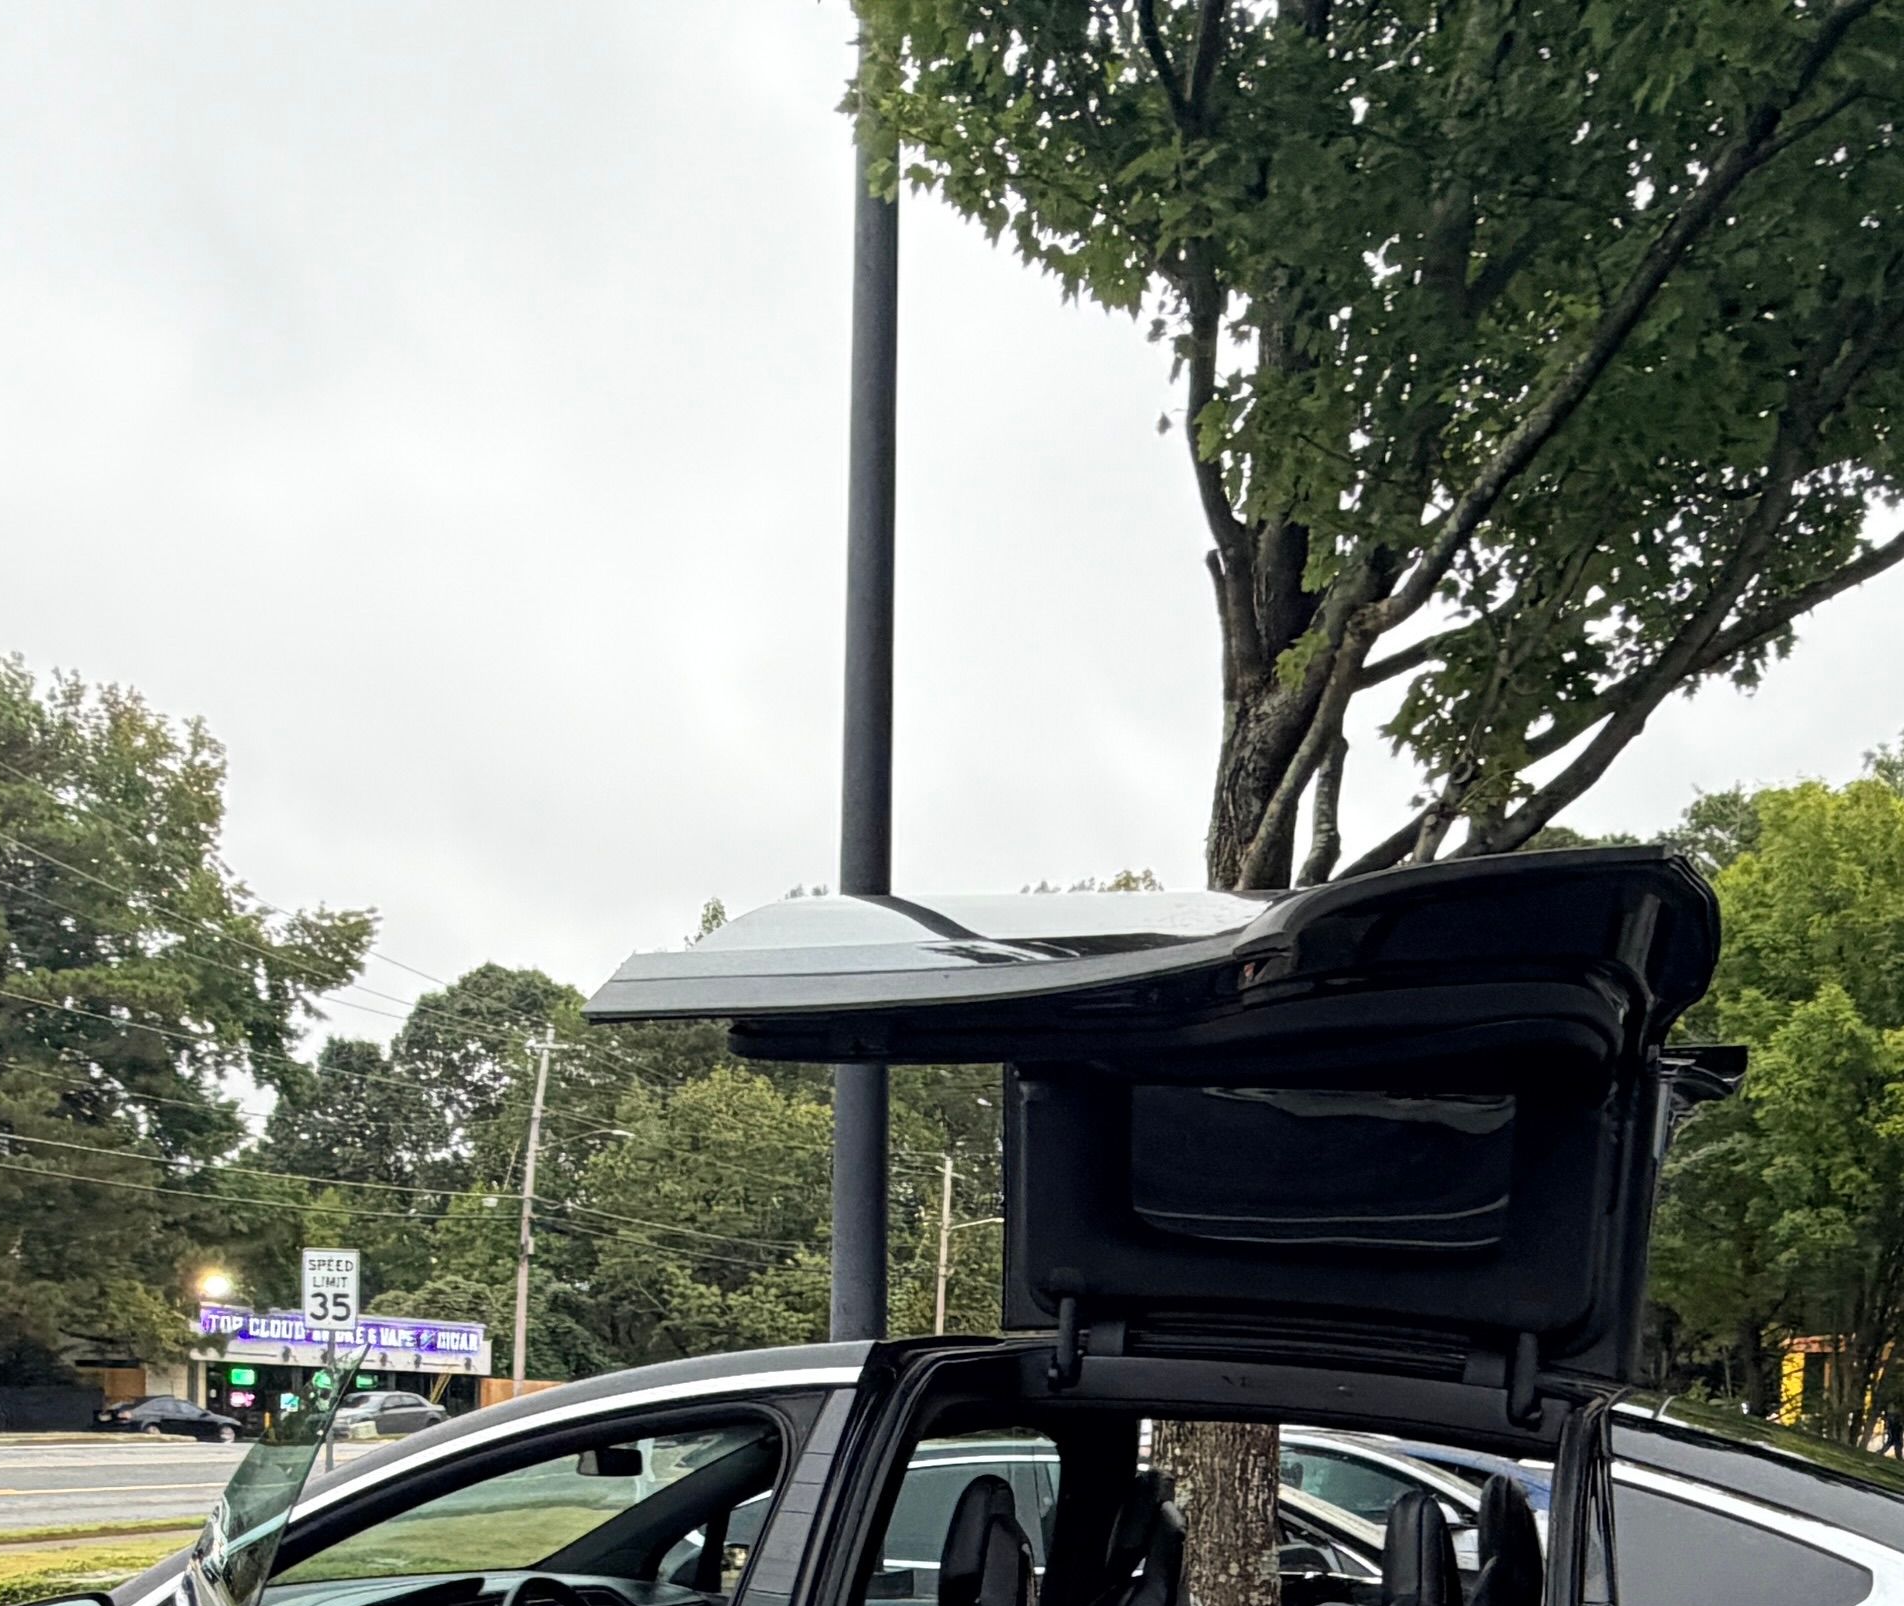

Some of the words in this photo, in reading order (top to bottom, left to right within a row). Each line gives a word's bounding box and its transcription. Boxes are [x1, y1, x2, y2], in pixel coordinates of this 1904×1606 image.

[308, 1259, 354, 1272] SPEED
[313, 1276, 348, 1288] LIMIT
[309, 1292, 352, 1321] 35
[208, 1313, 243, 1334] TOP
[249, 1318, 306, 1340] CLOUD
[380, 1328, 417, 1347] VAPE
